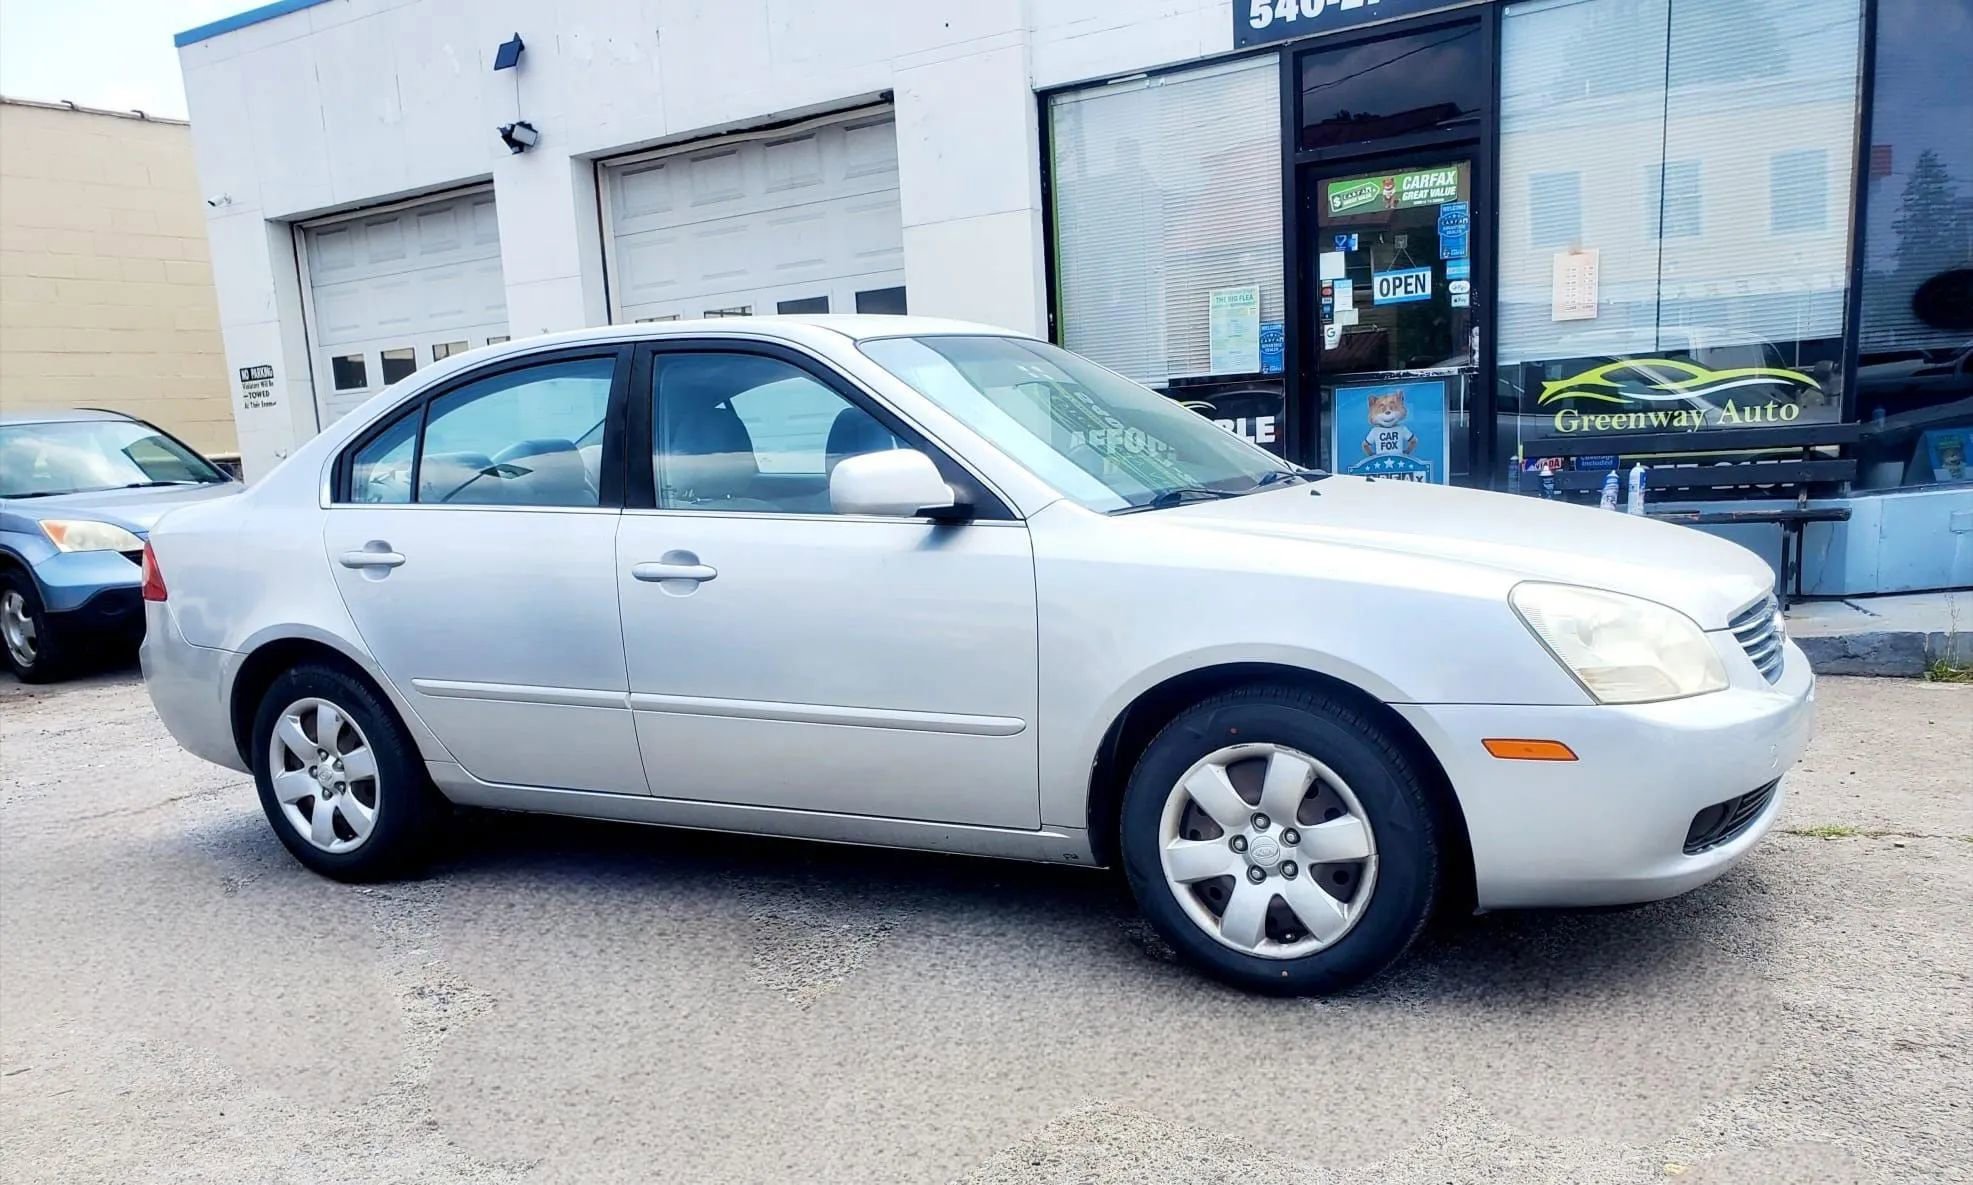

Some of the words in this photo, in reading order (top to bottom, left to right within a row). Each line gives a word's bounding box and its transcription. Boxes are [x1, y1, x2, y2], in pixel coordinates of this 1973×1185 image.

[1402, 170, 1456, 190] CARFAX
[1402, 188, 1428, 201] GREAT
[1430, 185, 1456, 197] VALUE
[1379, 273, 1426, 297] OPEN
[241, 368, 250, 381] NO
[250, 366, 273, 380] PARKING
[1554, 408, 1706, 432] Greenway
[1718, 398, 1799, 425] Auto
[1379, 431, 1399, 441] CAR
[1380, 441, 1399, 451] FOX
